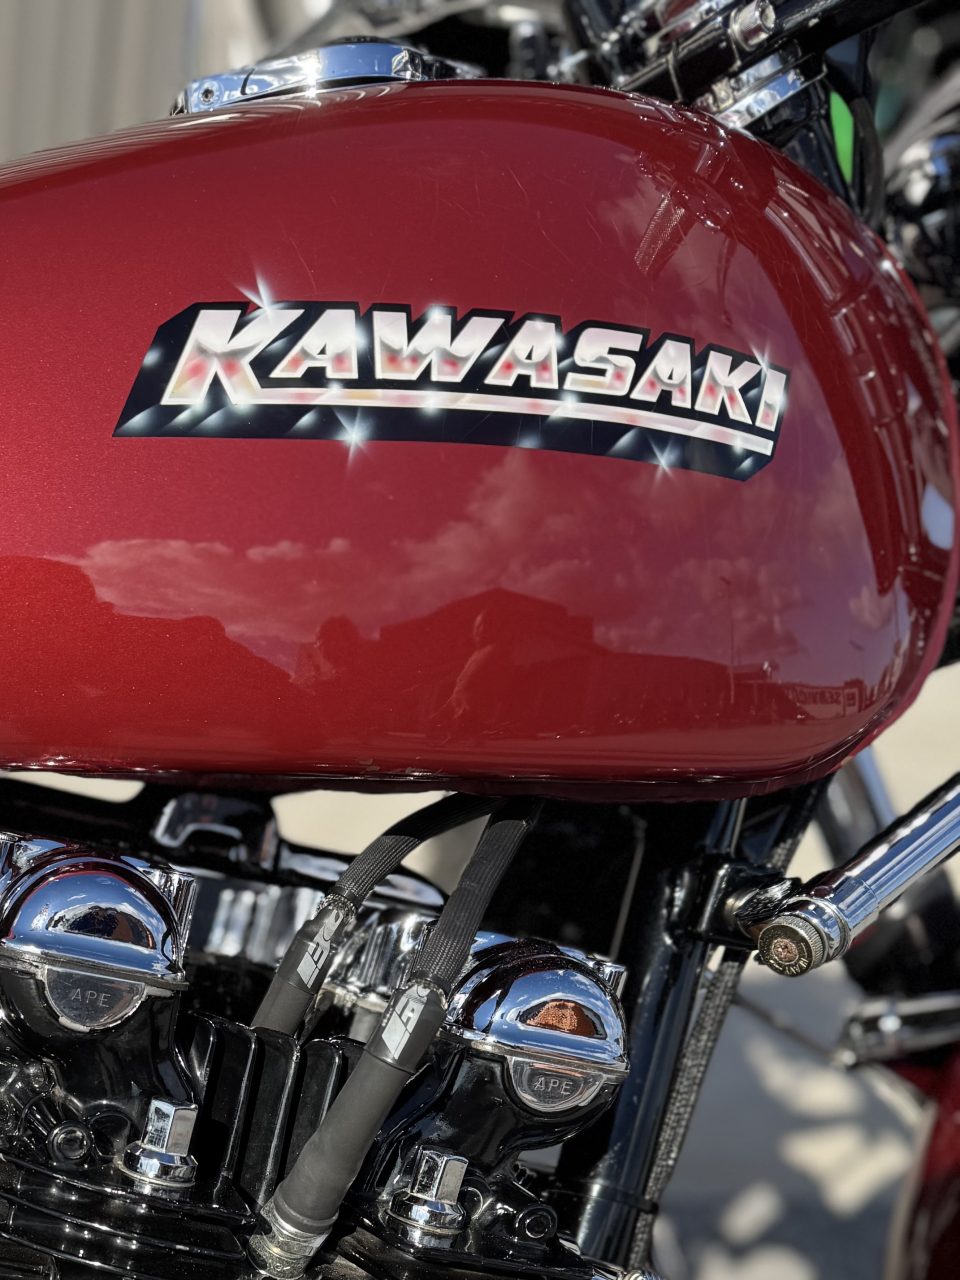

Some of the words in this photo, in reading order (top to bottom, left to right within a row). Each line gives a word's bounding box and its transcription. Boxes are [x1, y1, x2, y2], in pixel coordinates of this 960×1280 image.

[160, 308, 788, 434] KAWASAKI
[71, 987, 111, 1008] APE
[533, 1076, 574, 1095] APE
